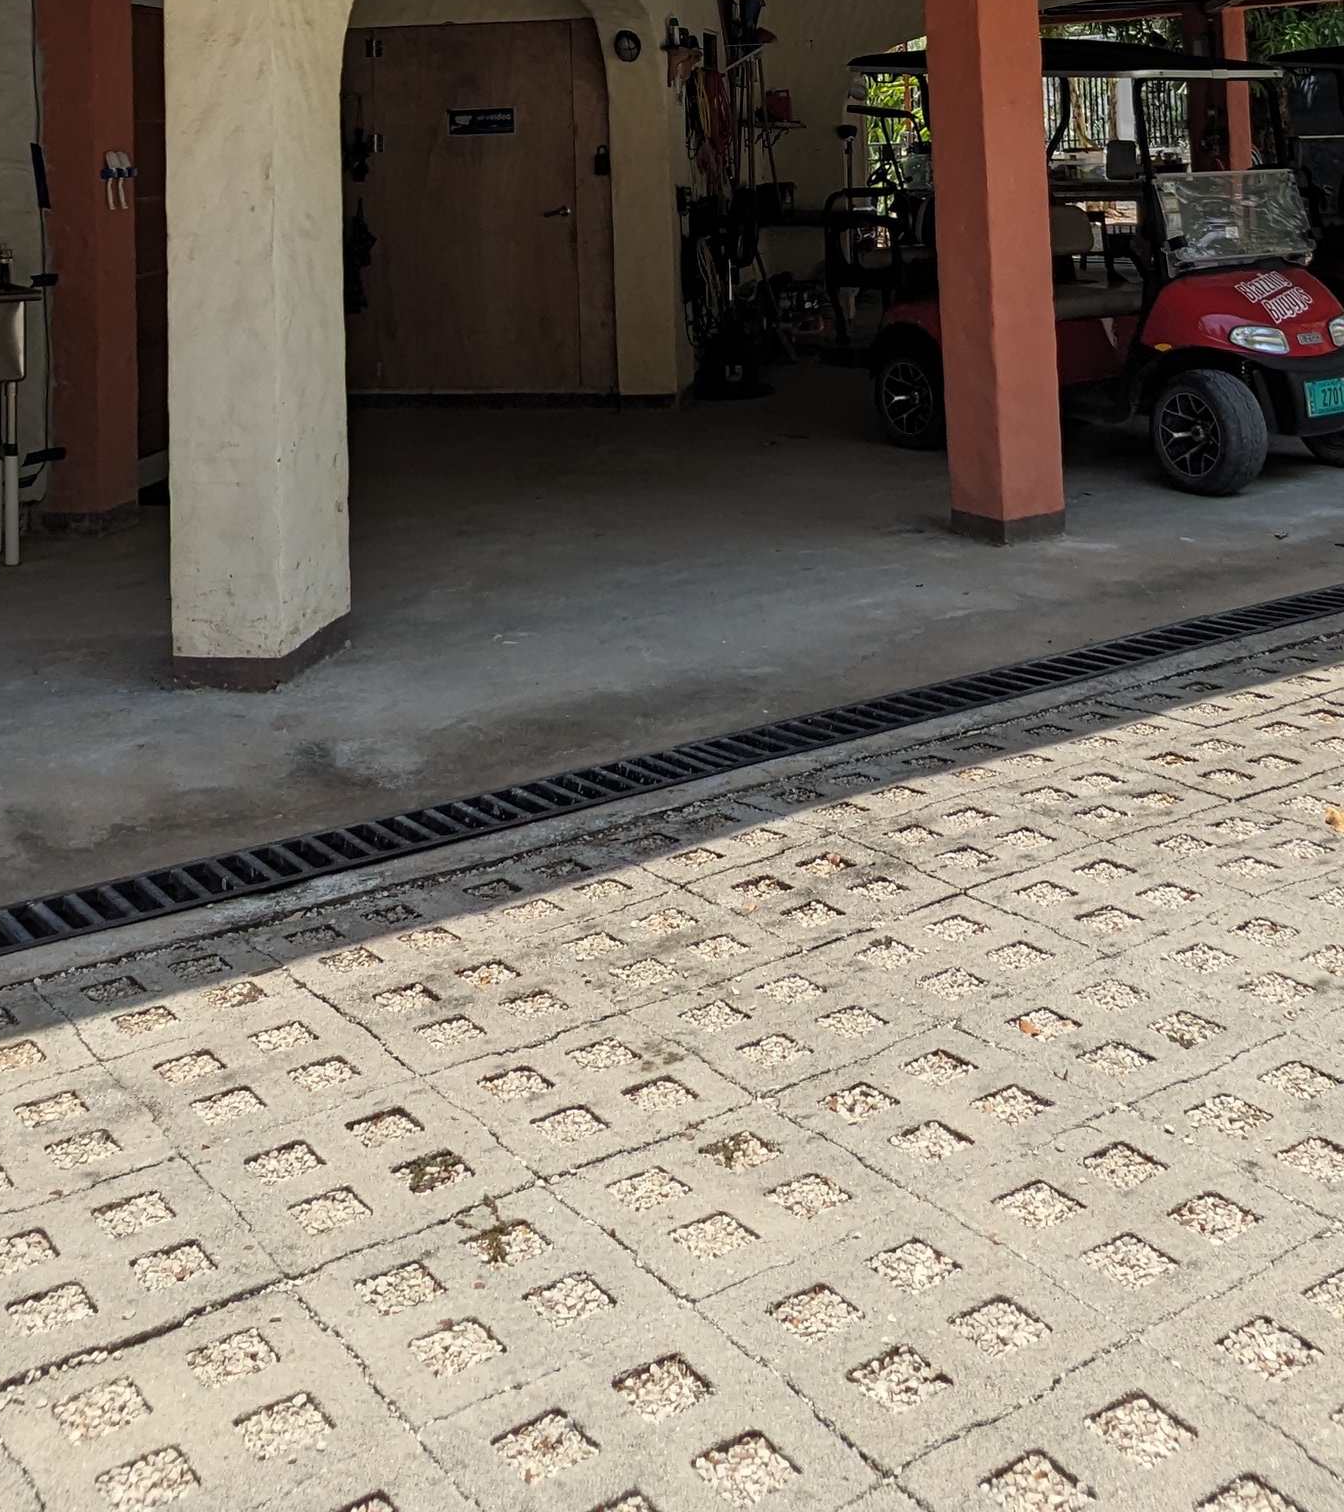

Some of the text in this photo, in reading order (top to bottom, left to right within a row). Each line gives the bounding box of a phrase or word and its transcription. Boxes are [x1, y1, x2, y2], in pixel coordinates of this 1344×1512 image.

[1234, 270, 1292, 303] Blazzing
[1260, 286, 1313, 324] Buggys
[1321, 385, 1344, 407] 2701
